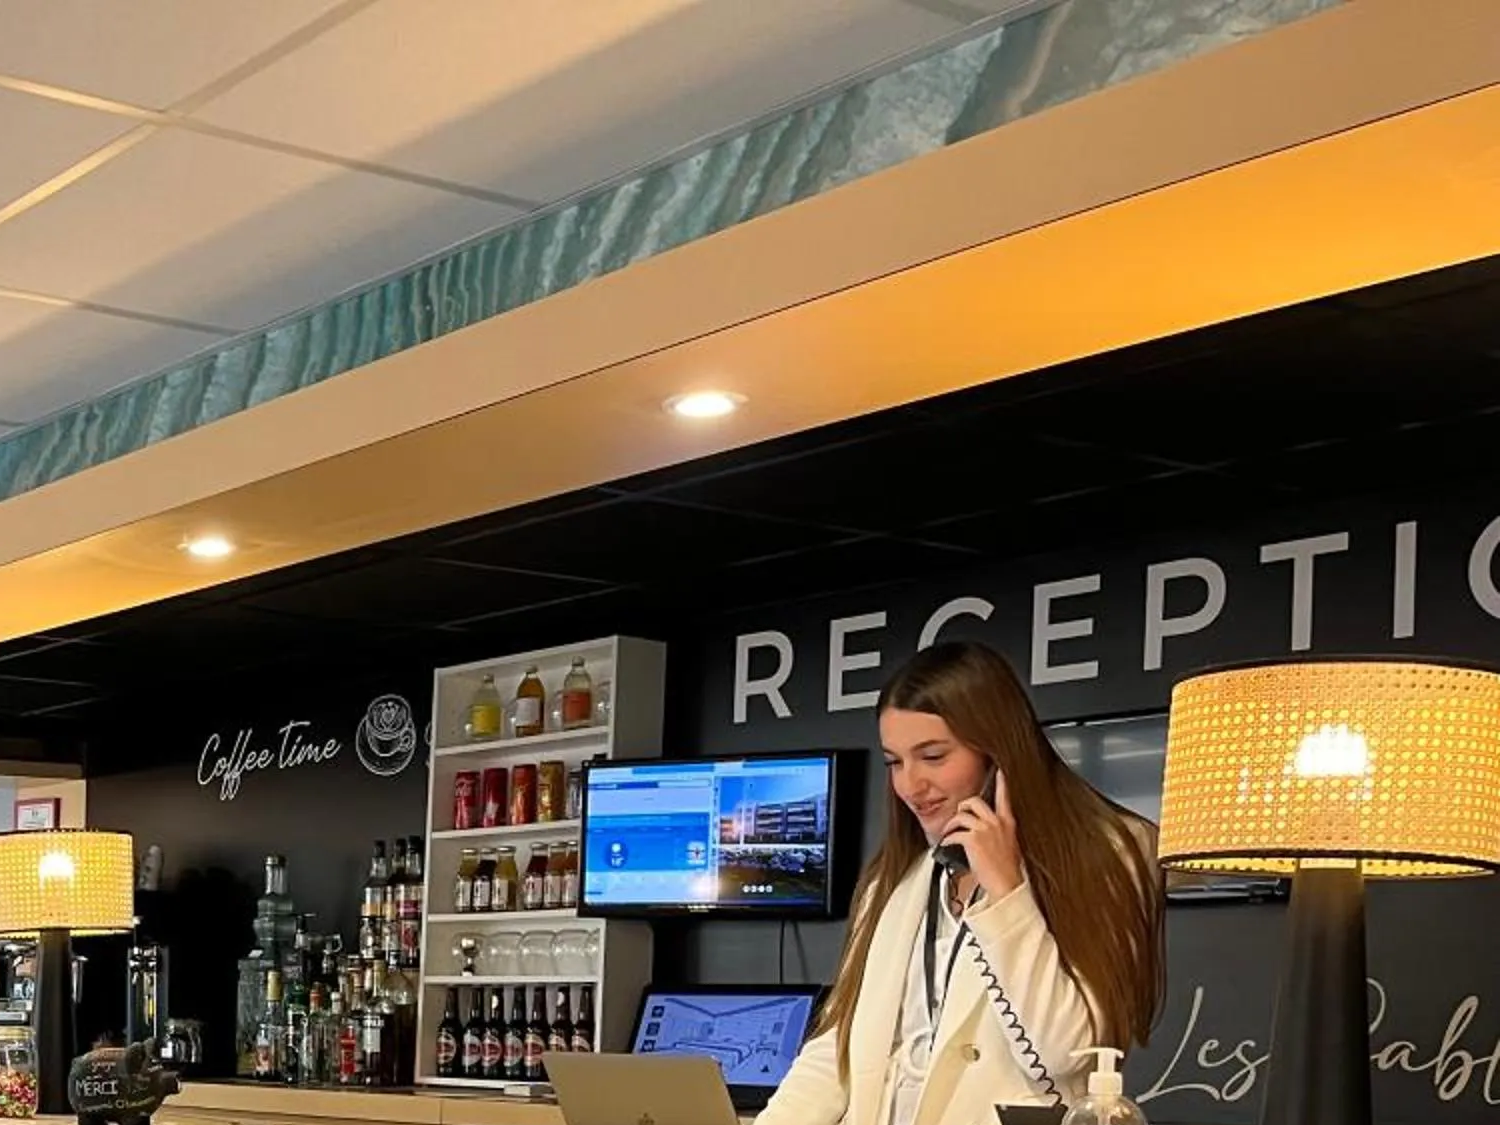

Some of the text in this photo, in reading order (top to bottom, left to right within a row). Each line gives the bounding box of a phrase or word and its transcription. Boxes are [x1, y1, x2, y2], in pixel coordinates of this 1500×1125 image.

[197, 720, 342, 800] Coffee Time
[1135, 986, 1271, 1103] Les
[76, 1079, 119, 1097] MERCI
